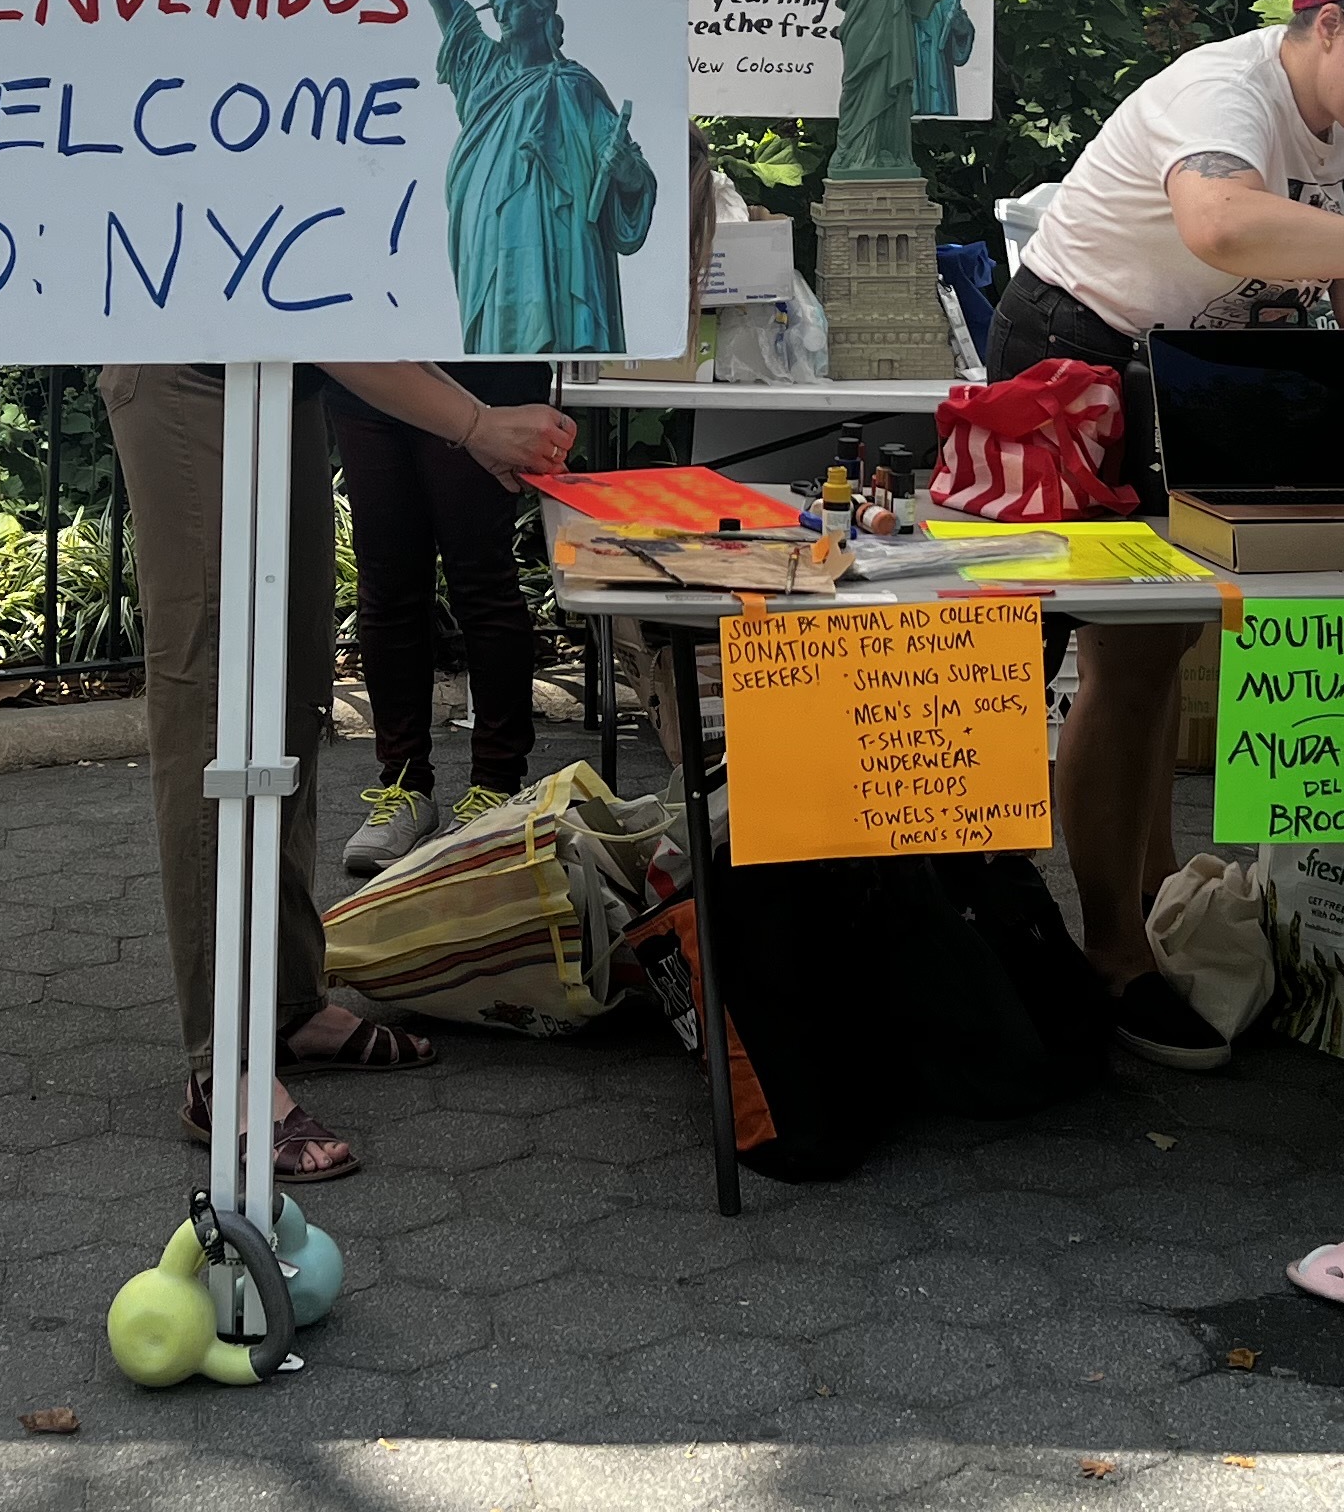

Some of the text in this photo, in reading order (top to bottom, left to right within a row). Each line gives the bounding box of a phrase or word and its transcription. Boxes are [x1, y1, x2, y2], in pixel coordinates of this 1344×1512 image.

[736, 56, 814, 74] Colossus
[104, 178, 418, 318] NYC!
[728, 617, 787, 640] SOUTH
[827, 611, 893, 633] MUTUAL
[900, 609, 930, 628] AID
[939, 604, 1038, 625] COLLECTING
[1236, 614, 1344, 655] SOUTH
[728, 629, 975, 665] DONATIONS FOR ASYLUM
[731, 663, 821, 692] SEEKERS!
[853, 662, 1032, 691] SHAVING SUPPLIES
[861, 748, 980, 773] UNDERWEAR
[1228, 730, 1340, 779] AYUDA
[861, 775, 968, 800] FLIP-FLOPS
[1303, 779, 1342, 798] DEL
[860, 806, 935, 831] TOWELS
[952, 799, 1047, 823] SWIMSUITS
